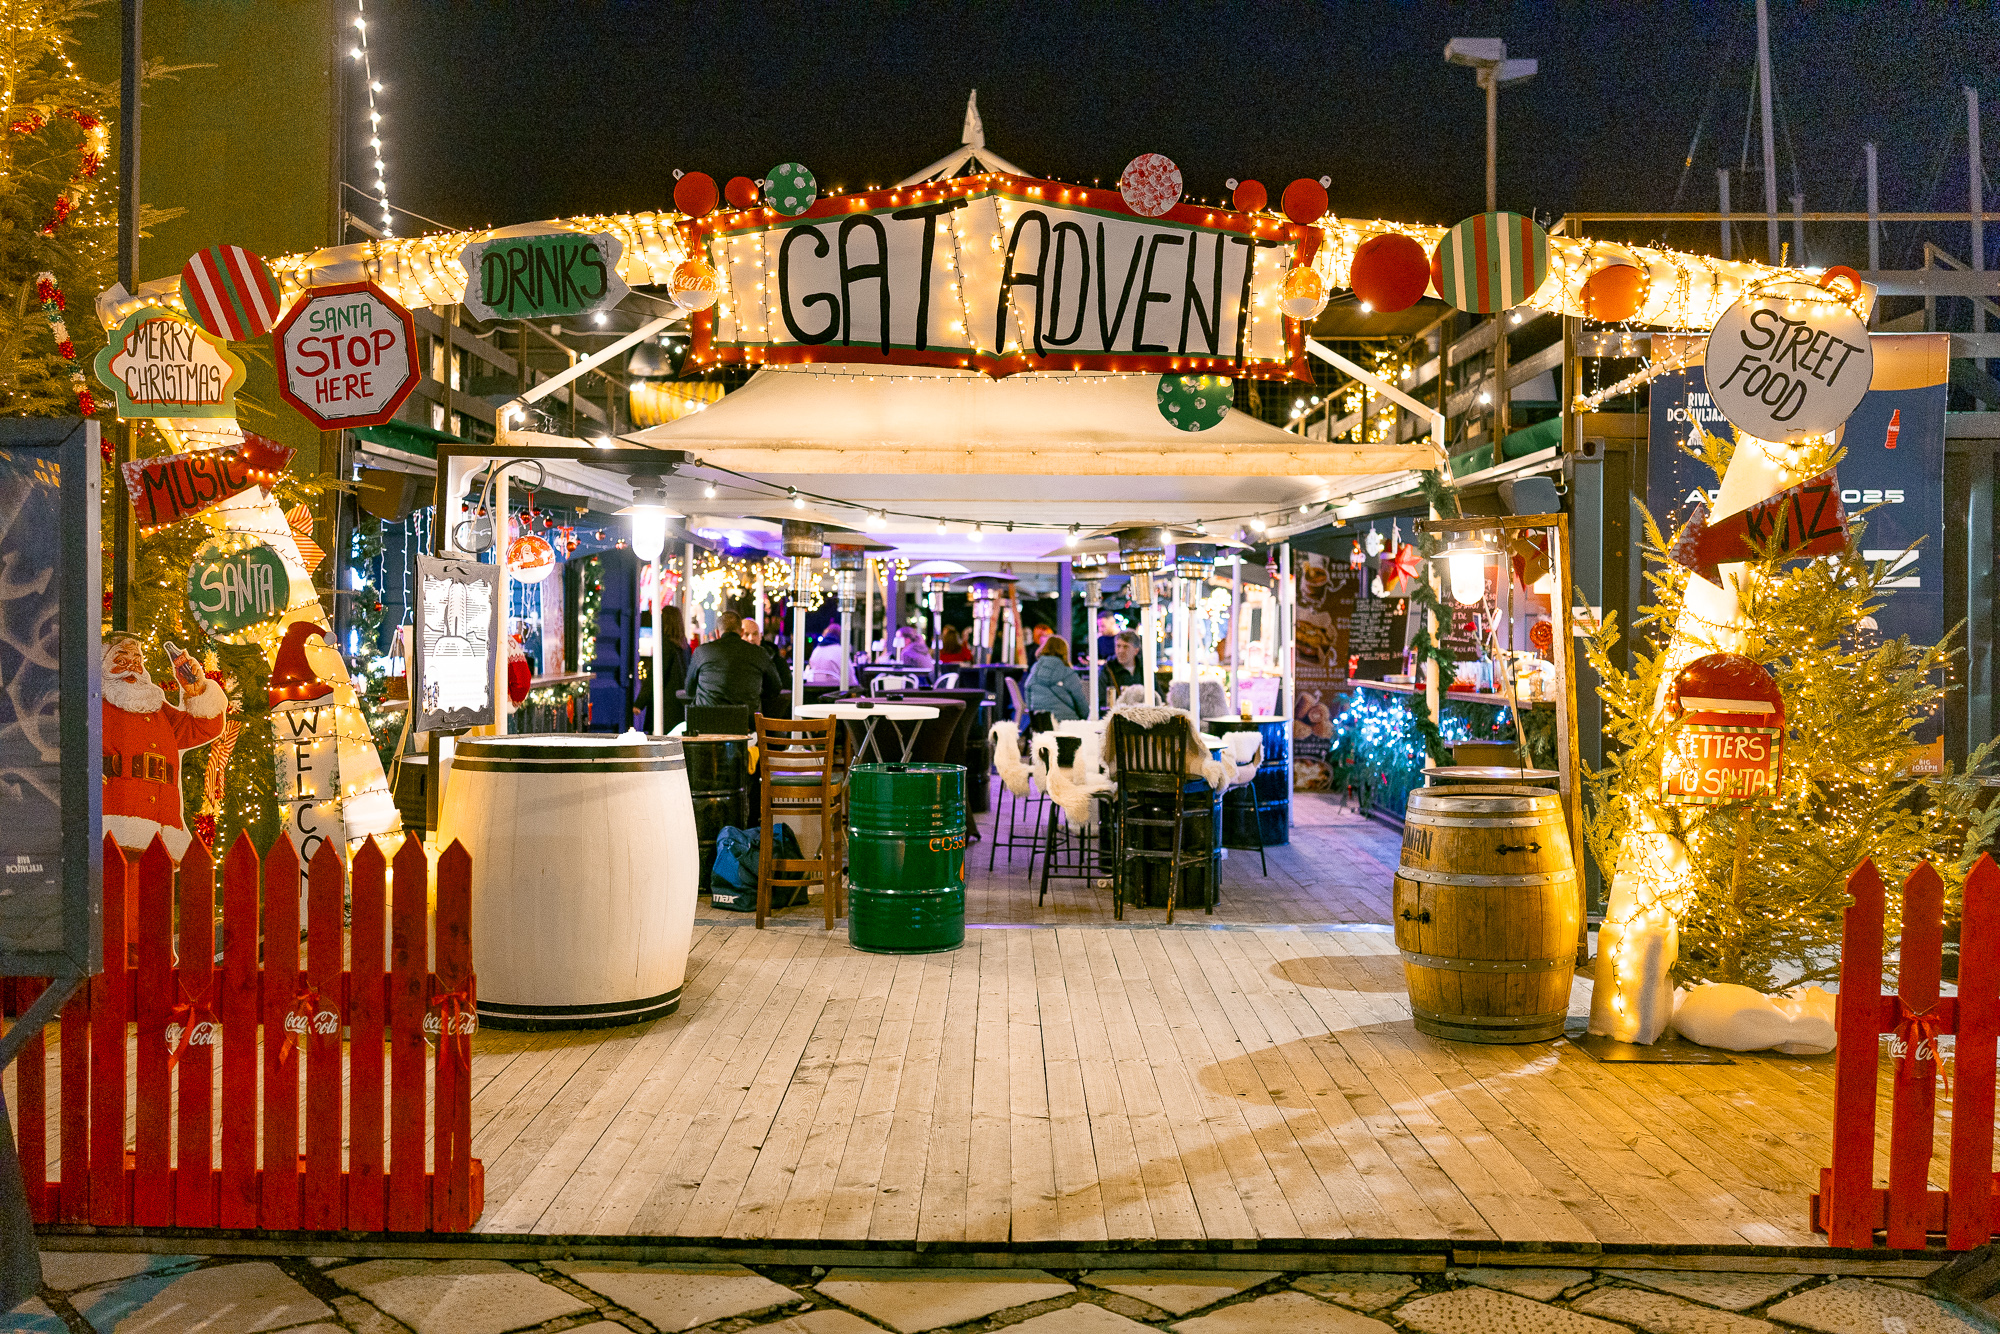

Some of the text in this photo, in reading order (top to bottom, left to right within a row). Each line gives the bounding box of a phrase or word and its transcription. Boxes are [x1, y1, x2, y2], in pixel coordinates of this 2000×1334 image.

[481, 243, 608, 313] DRINKS
[778, 197, 1278, 367] GAT ADVENT
[127, 319, 198, 362] MERRY
[309, 302, 373, 333] SANTA
[295, 329, 396, 378] STOP
[1740, 308, 1865, 387] STREET
[125, 363, 221, 411] CHRISTMAS
[315, 371, 375, 404] HERE
[1687, 392, 1711, 407] RIVA
[1719, 354, 1808, 421] FOOD
[141, 450, 247, 525] MUSIC
[199, 553, 276, 618] SANTA
[1702, 768, 1766, 796] SANTA
